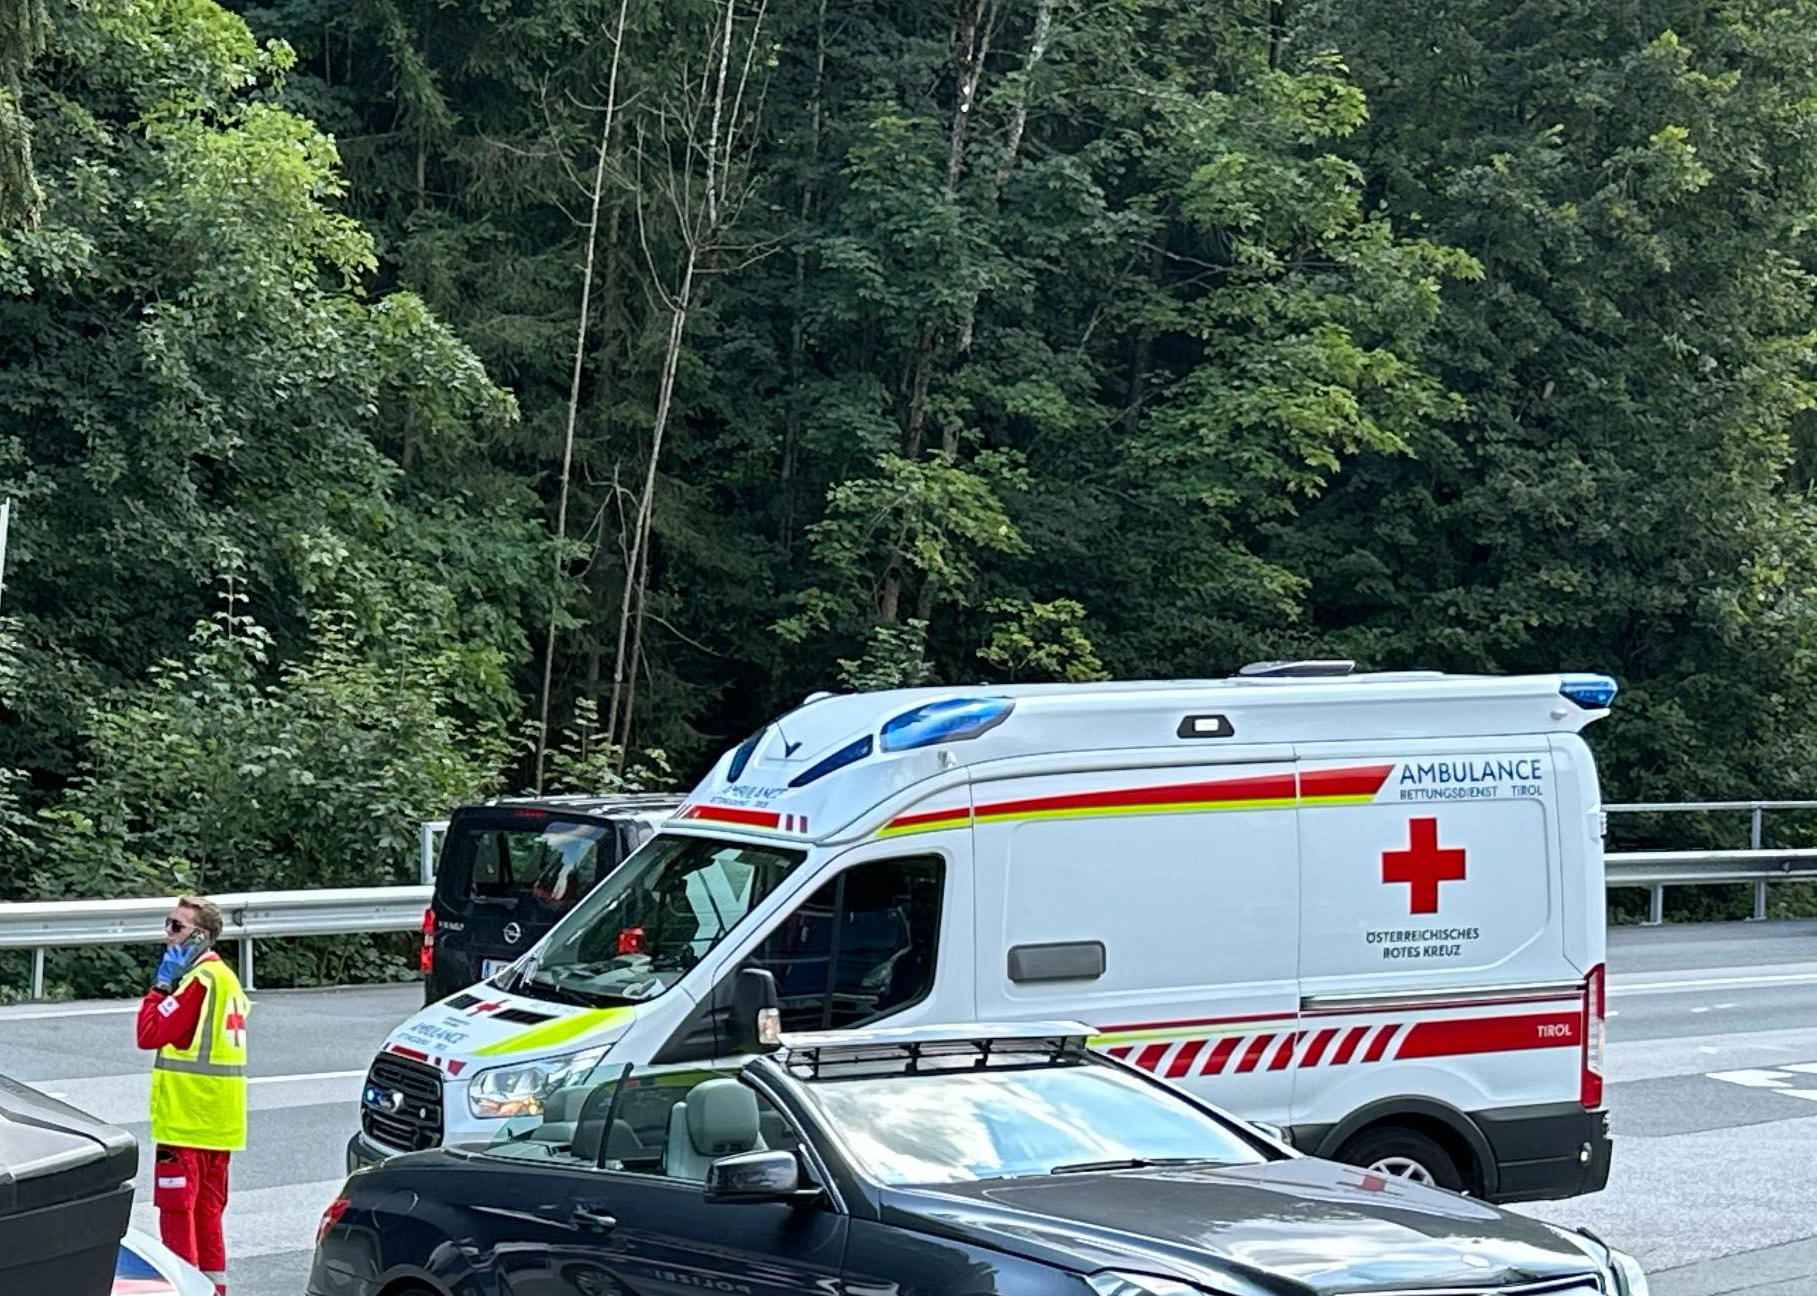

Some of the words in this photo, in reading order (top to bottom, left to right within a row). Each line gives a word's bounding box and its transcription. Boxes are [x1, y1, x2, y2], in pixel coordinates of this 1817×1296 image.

[1399, 759, 1543, 785] AMBULANCE
[1399, 786, 1499, 801] RETTUNGSDIENST
[1511, 784, 1544, 797] TIROL
[1365, 927, 1480, 944] ÖSTERREICHISCHES
[1383, 945, 1422, 960] ROTES
[1423, 944, 1462, 958] KREUZ
[1536, 1023, 1574, 1039] TIROL
